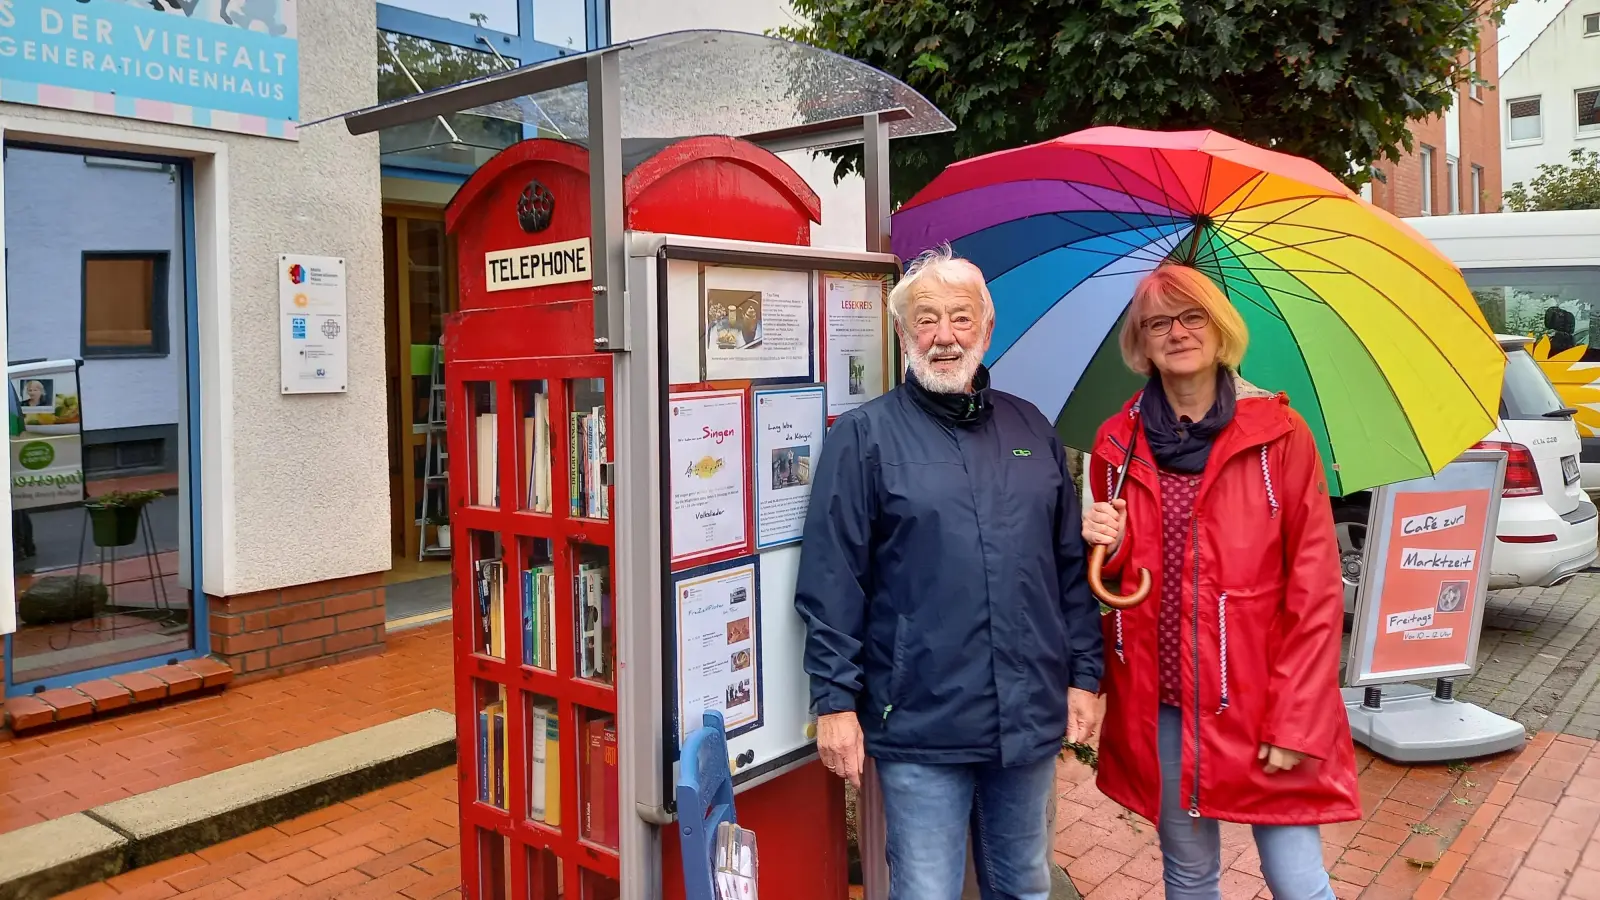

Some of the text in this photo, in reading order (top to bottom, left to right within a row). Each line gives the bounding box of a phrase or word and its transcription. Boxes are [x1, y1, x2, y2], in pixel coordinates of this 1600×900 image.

[41, 8, 113, 45] DER
[134, 25, 287, 76] VIELFALT
[489, 247, 586, 283] TELEPHONE
[841, 300, 873, 310] LESEKREIS
[702, 426, 735, 444] Singen
[1403, 515, 1464, 534] Café zur
[1403, 552, 1471, 568] Marktzeit
[1389, 613, 1432, 627] Freitags
